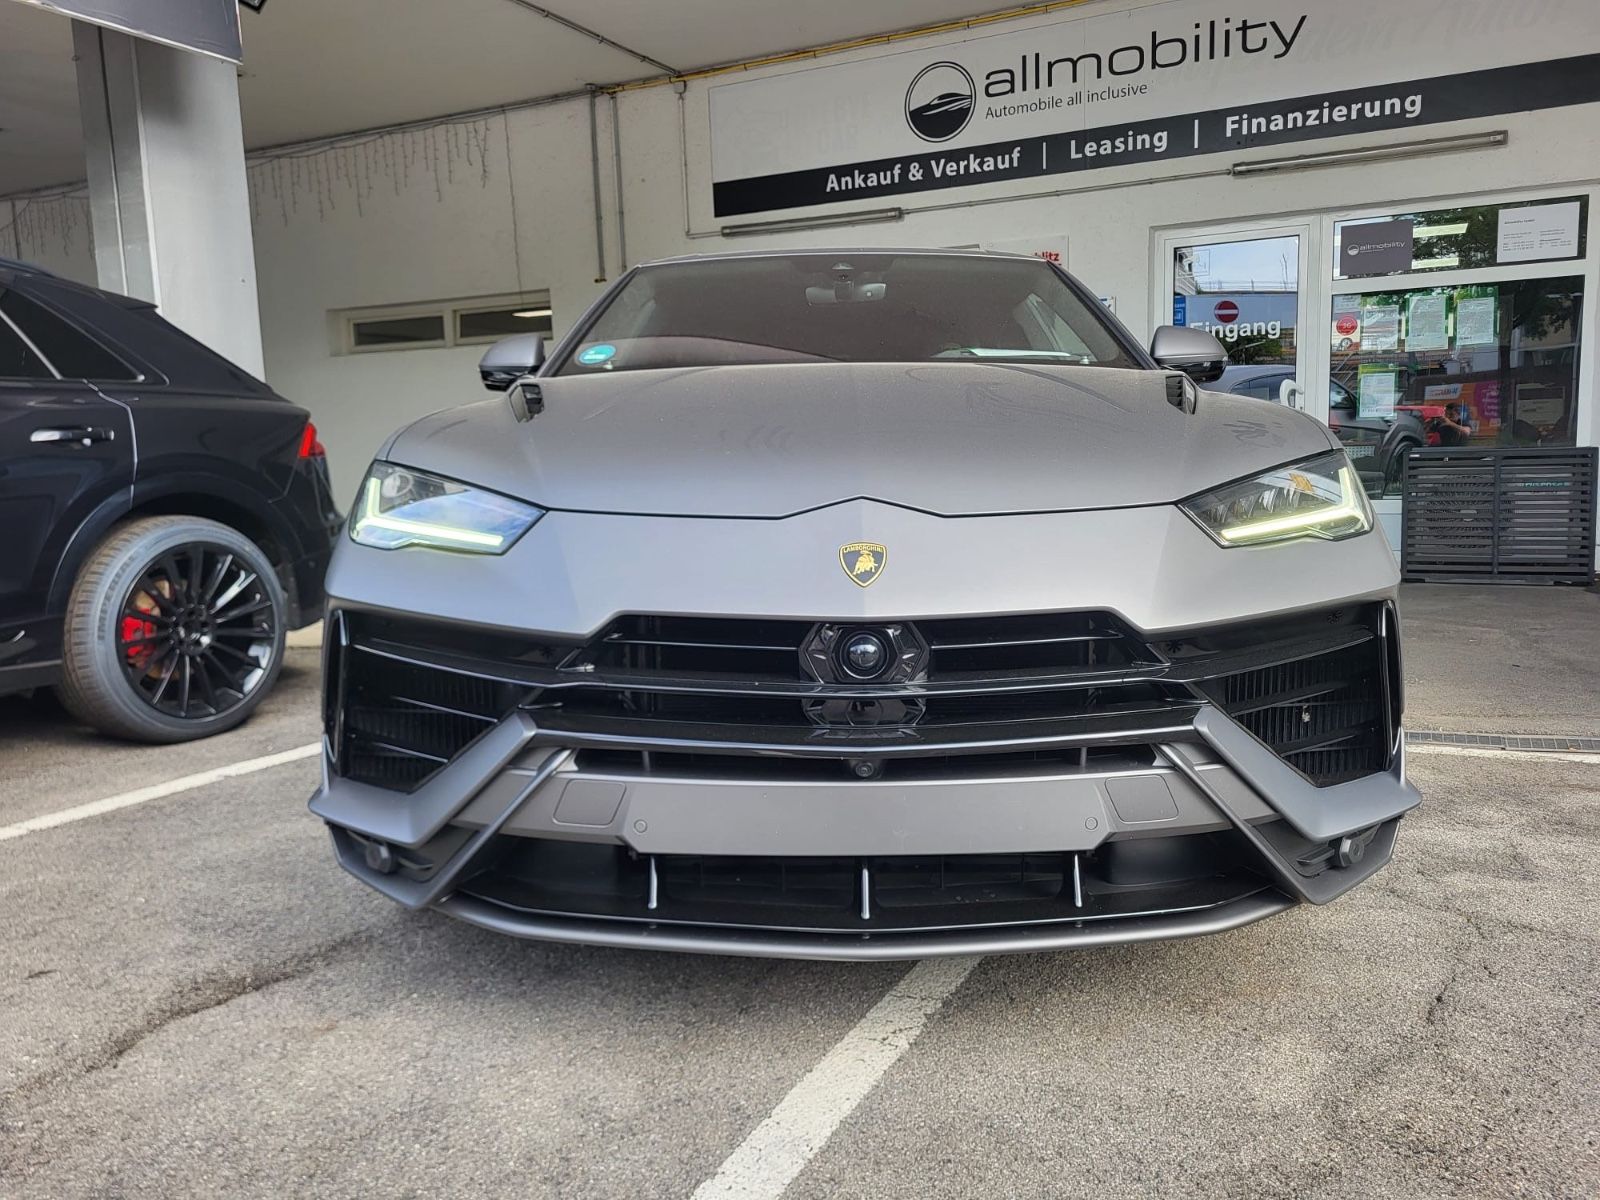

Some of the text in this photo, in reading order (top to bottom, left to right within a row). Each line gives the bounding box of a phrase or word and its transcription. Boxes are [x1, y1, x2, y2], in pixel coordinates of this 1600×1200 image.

[985, 15, 1307, 98] allmobility
[985, 84, 1148, 120] Automobile all inclusive
[825, 164, 901, 192] Ankauf
[908, 162, 924, 181] &
[930, 147, 1021, 179] Verkauf
[1070, 129, 1169, 159] Leasing
[1226, 94, 1422, 138] Finanzierung
[1360, 241, 1405, 251] allmobility
